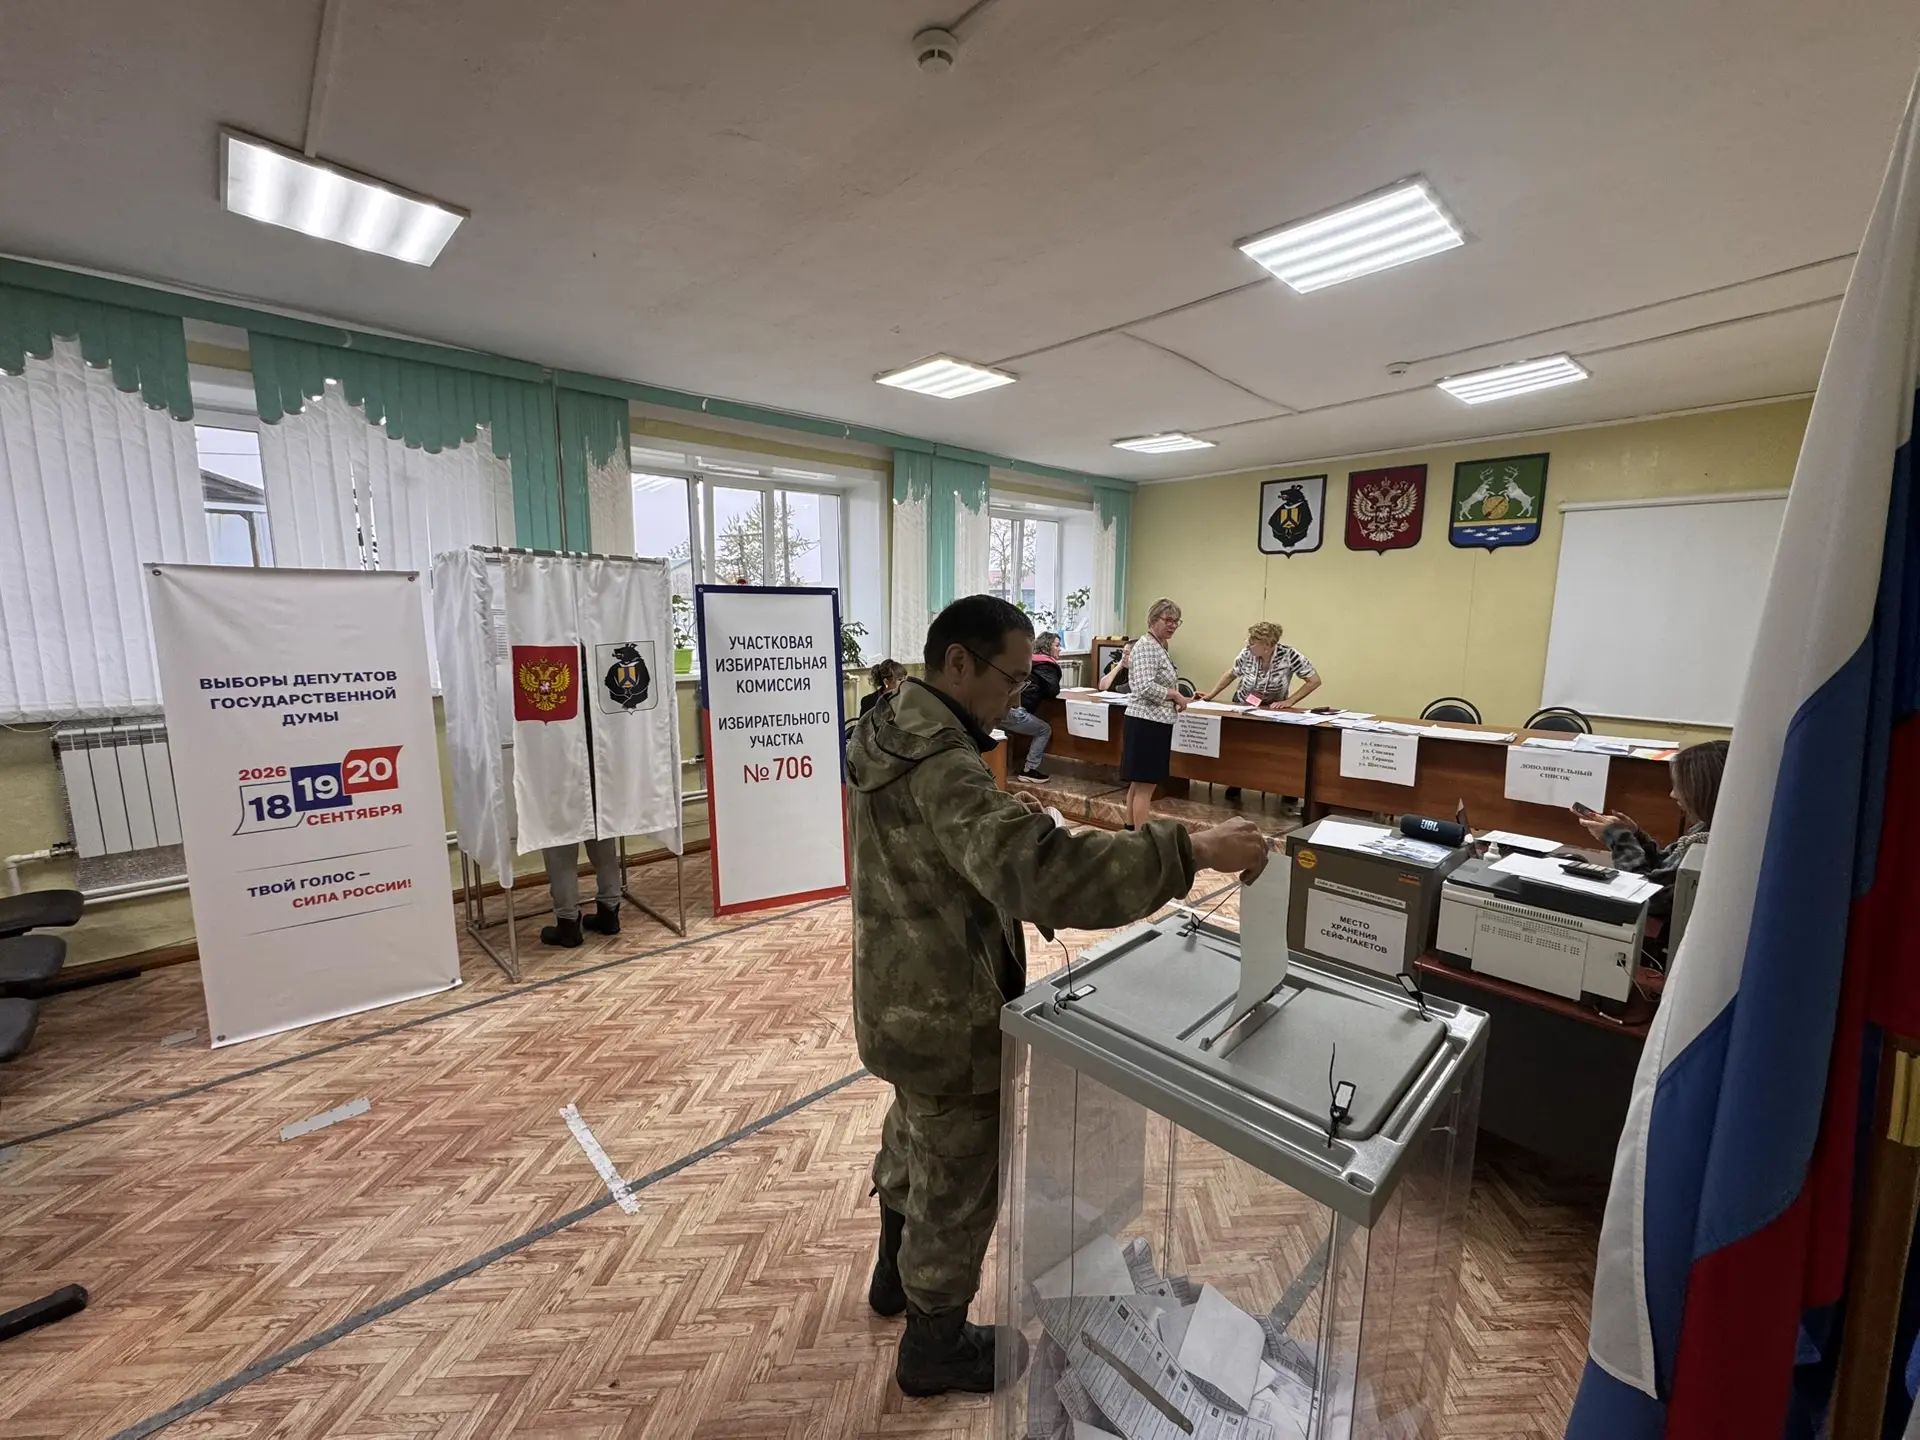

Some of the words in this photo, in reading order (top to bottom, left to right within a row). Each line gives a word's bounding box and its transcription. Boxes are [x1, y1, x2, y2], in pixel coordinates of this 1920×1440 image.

[729, 635, 813, 650] УЧАСТКОВАЯ
[715, 656, 827, 673] ИЗБИРАТЕЛЬНАЯ
[200, 675, 288, 690] ВЫБОРЫ
[293, 671, 397, 687] ДЕПУТАТОВ
[736, 677, 811, 693] КОМИССИЯ
[210, 686, 397, 709] ГОСУДАРСТВЕННОЙ
[282, 711, 339, 726] ДУМЫ
[718, 711, 830, 730] ИЗБИРАТЕЛЬНОГО
[750, 733, 804, 748] УЧАСТКА
[238, 766, 287, 781] 2026
[773, 755, 813, 781] 706
[1520, 763, 1593, 776] ДОПОЛНИТЕЛЬНЫЙ
[1539, 772, 1570, 781] СПИСОК
[248, 794, 292, 821] 18
[298, 775, 339, 801] 19
[346, 757, 393, 784] 20
[306, 804, 403, 826] СЕНТЯБРЯ
[1420, 818, 1440, 832] JBL
[247, 878, 296, 897] ТВОЙ
[300, 871, 355, 888] ГОЛОС
[292, 892, 338, 908] СИЛА
[343, 878, 412, 899] РОССИИ!
[1331, 922, 1378, 941] ХРАНЕНИЯ
[1340, 915, 1370, 930] МЕСТО
[1320, 928, 1388, 954] СЕЙФ-ПАКЕТОВ
